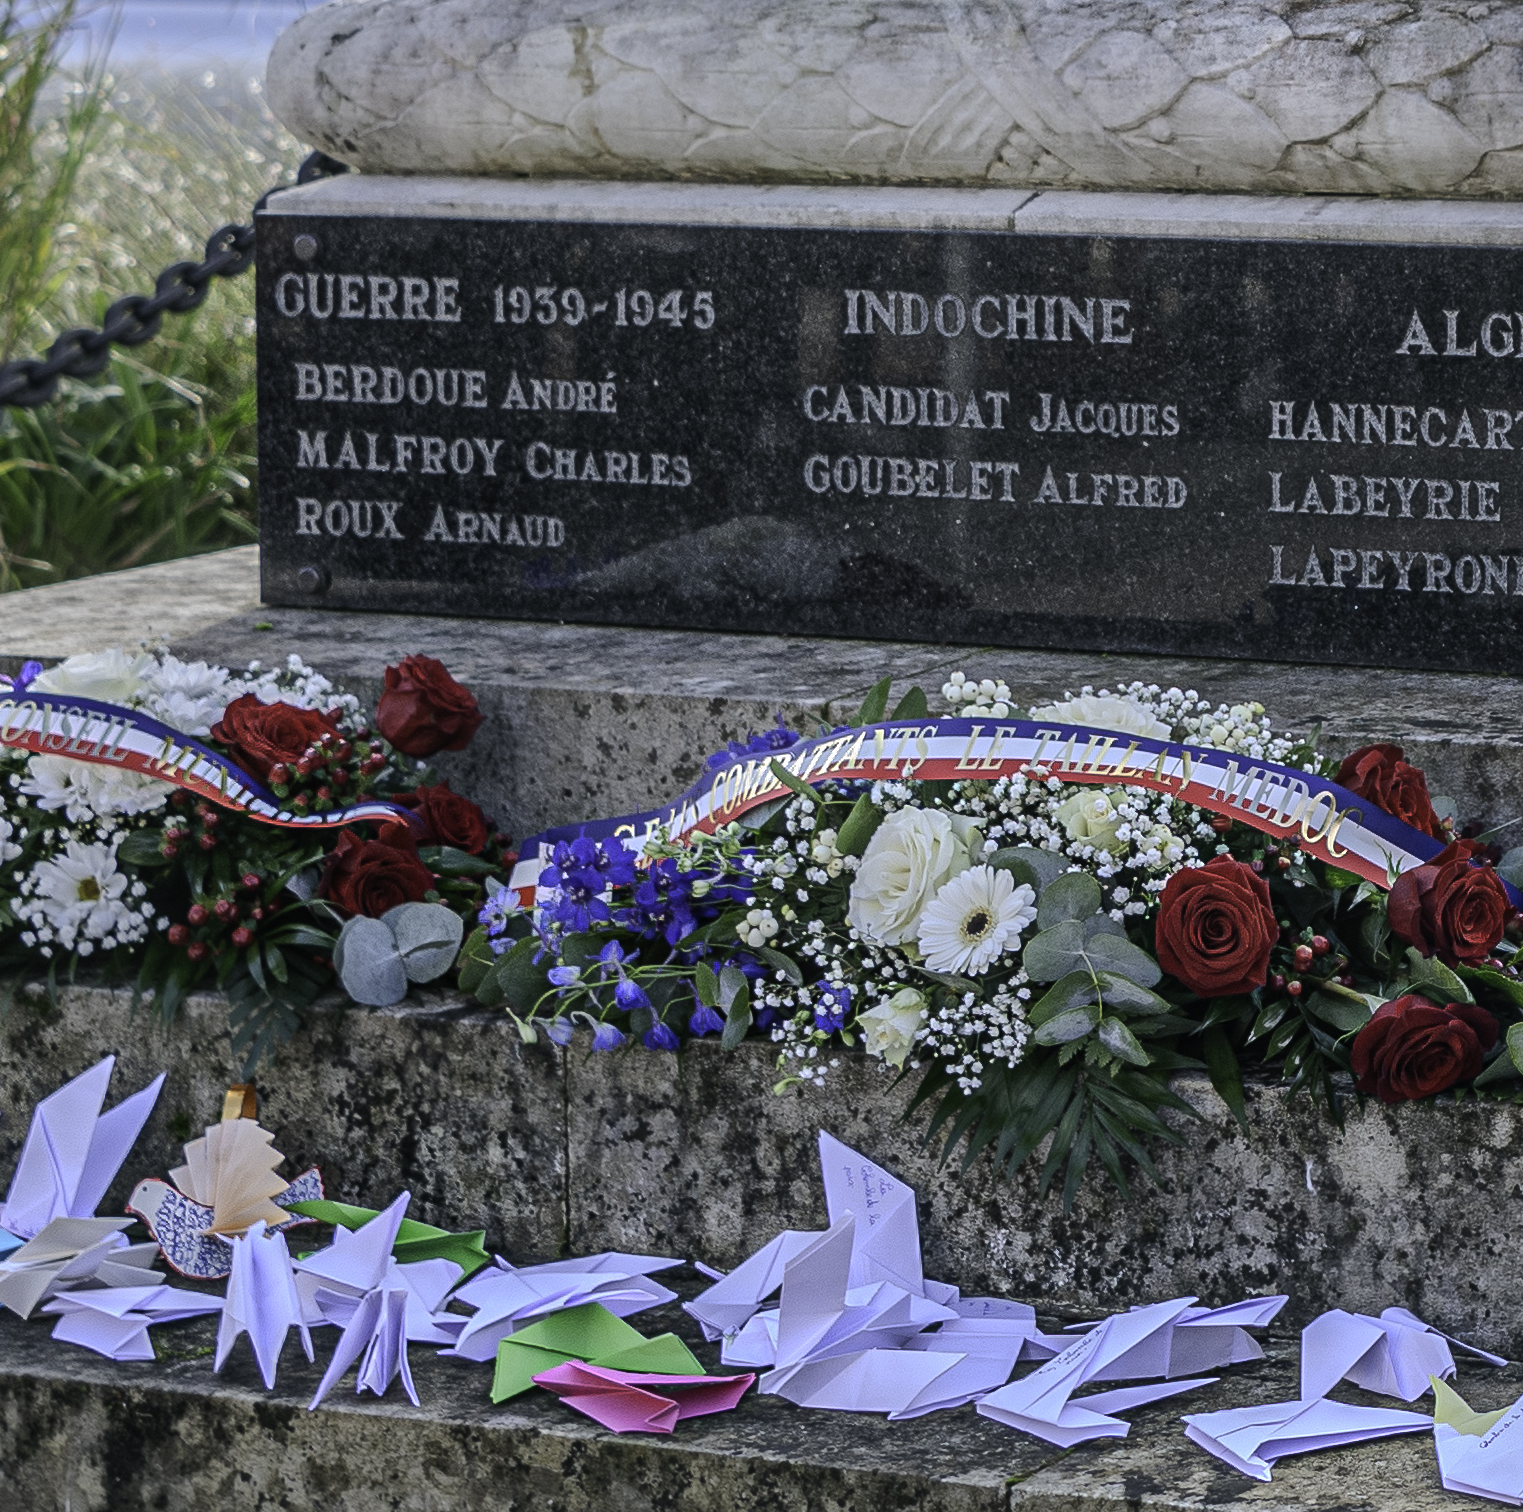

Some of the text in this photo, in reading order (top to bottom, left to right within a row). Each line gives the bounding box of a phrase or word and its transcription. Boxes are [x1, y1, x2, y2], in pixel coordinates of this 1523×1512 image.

[276, 272, 716, 330] GUERRE 1939-1945
[844, 289, 1133, 344] INDOCHINE
[294, 362, 618, 413] BERDOUE ANDRÉ
[803, 384, 1010, 430] CANDIDAT
[296, 429, 505, 477] MALFROY
[803, 453, 1020, 502] GOUBELET
[296, 497, 406, 540] ROUX
[1268, 471, 1501, 522] LABEYRIE
[955, 725, 1017, 770] LE
[1027, 729, 1209, 794] TAILLAN
[1208, 759, 1364, 858] MEDOC
